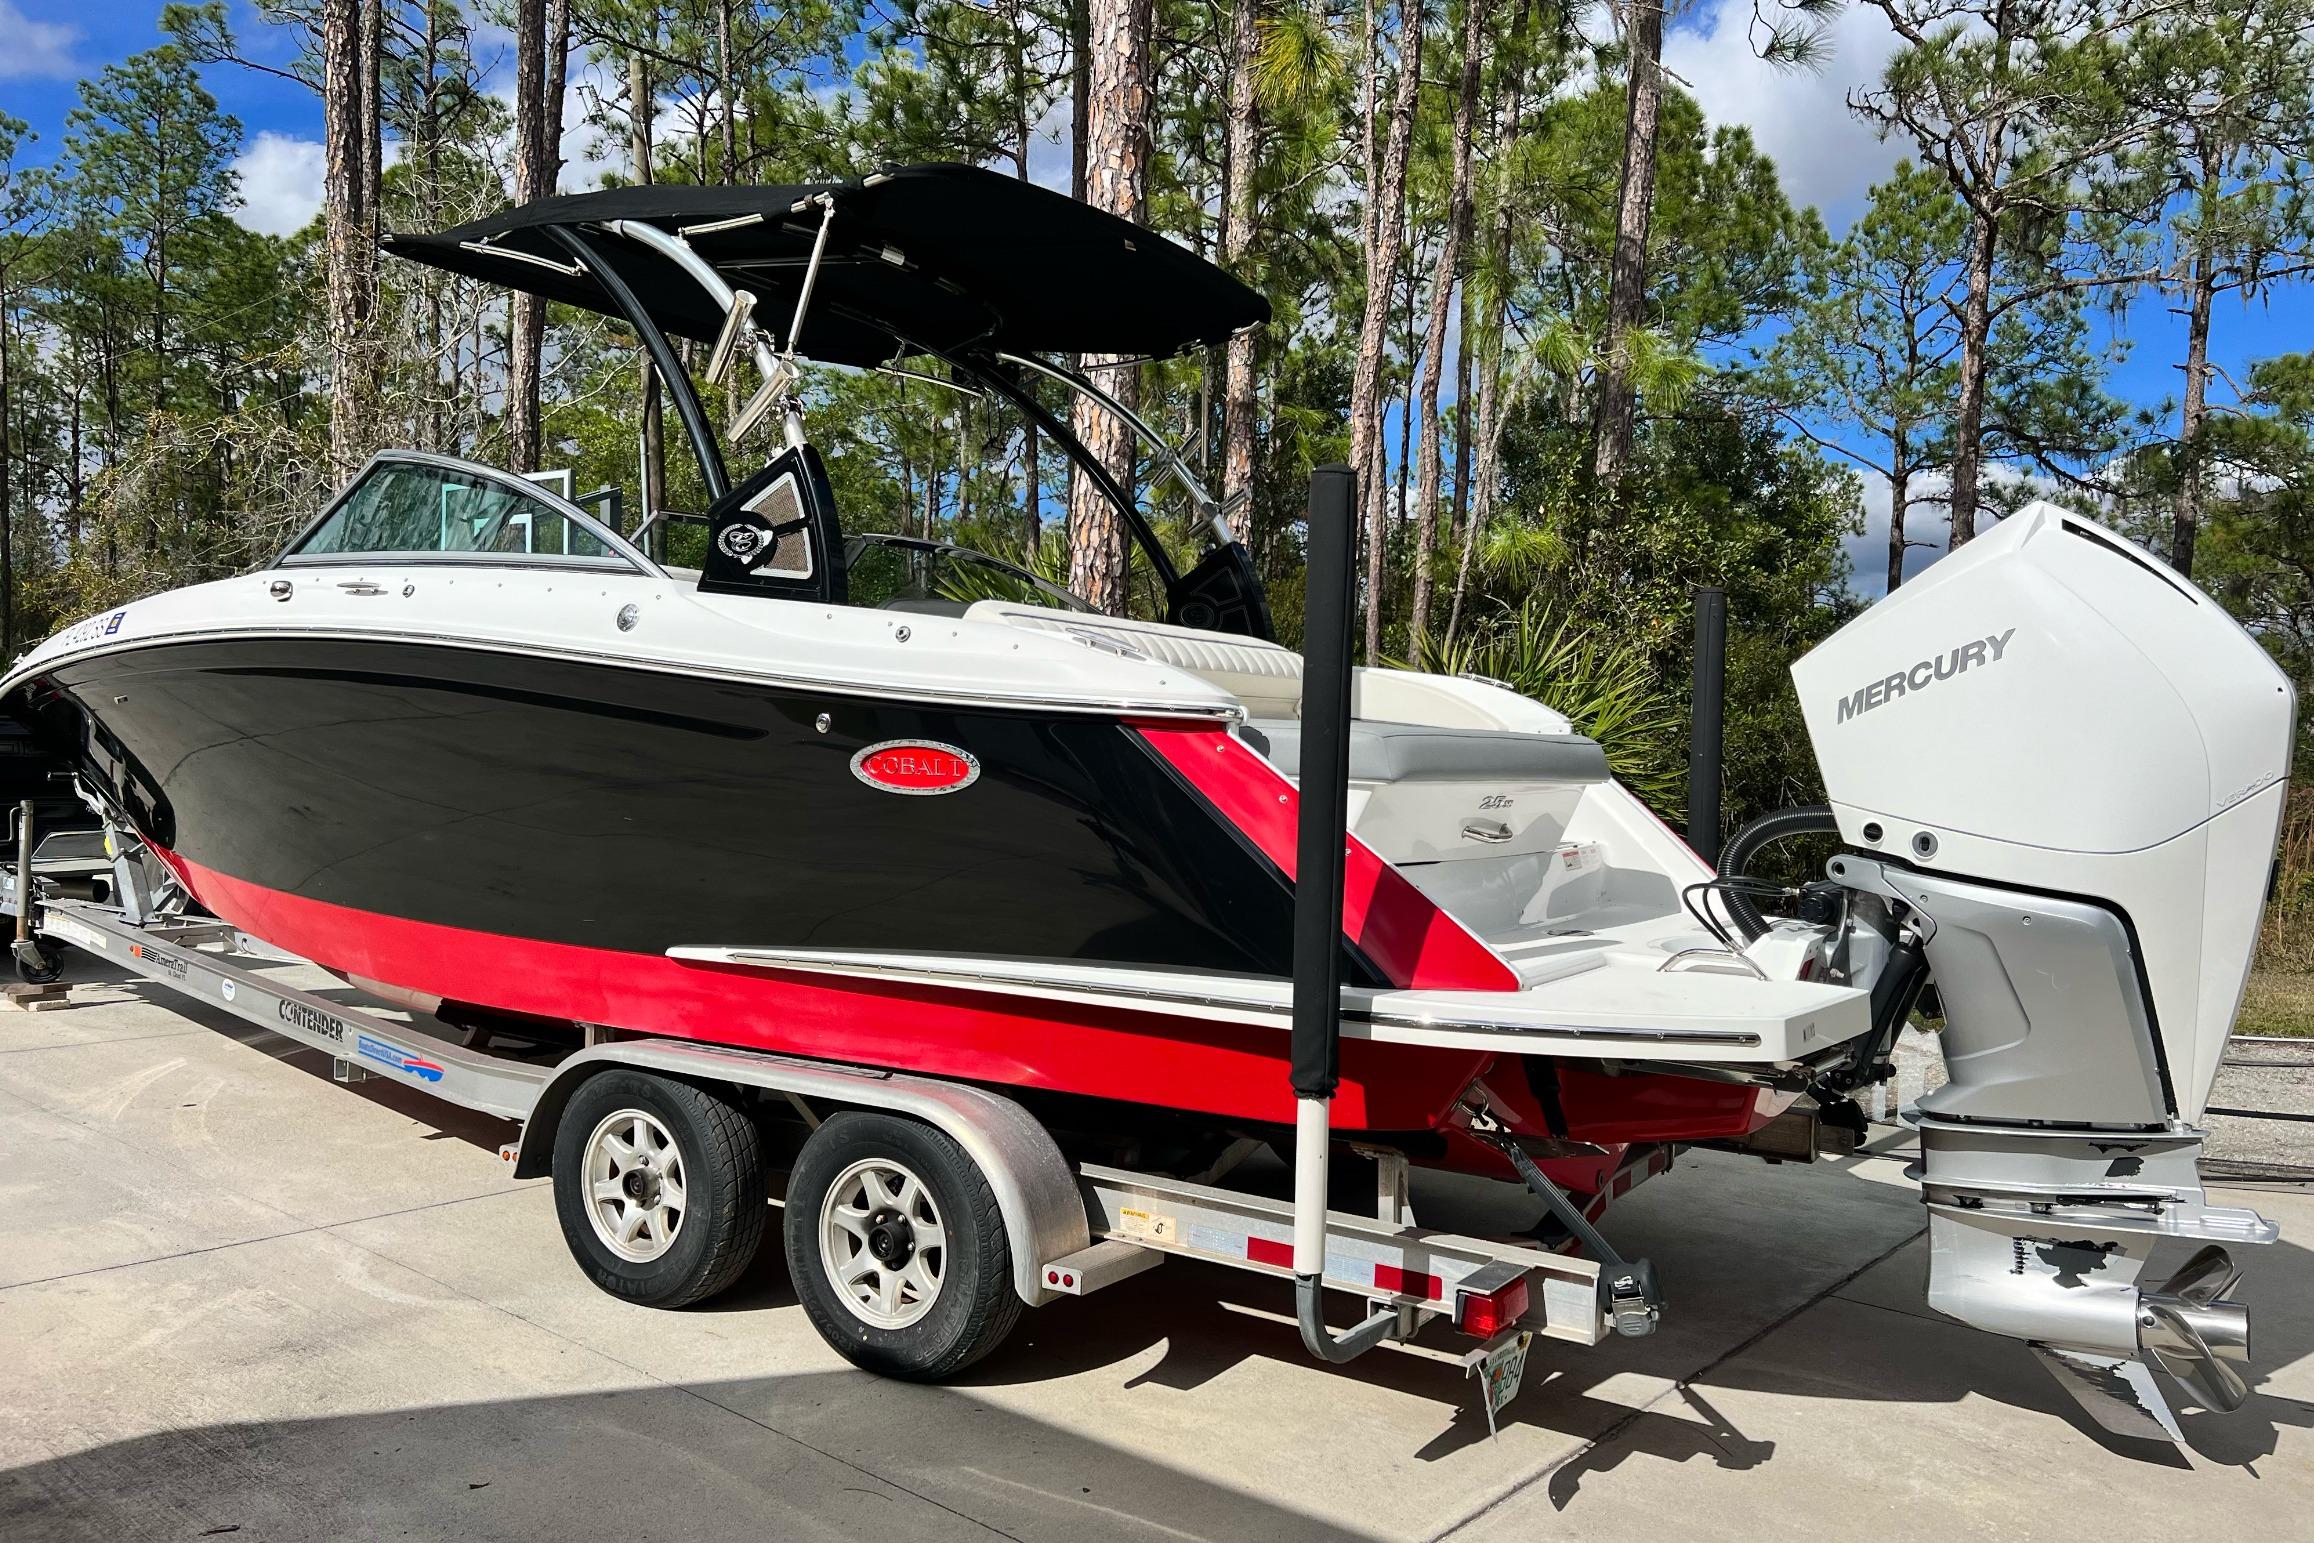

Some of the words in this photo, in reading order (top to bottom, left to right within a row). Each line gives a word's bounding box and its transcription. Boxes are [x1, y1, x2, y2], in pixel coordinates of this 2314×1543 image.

[1837, 627, 2016, 725] MERCURY
[866, 755, 967, 777] COBALT
[2216, 770, 2274, 807] VERADO
[278, 999, 344, 1042] CONTENDER
